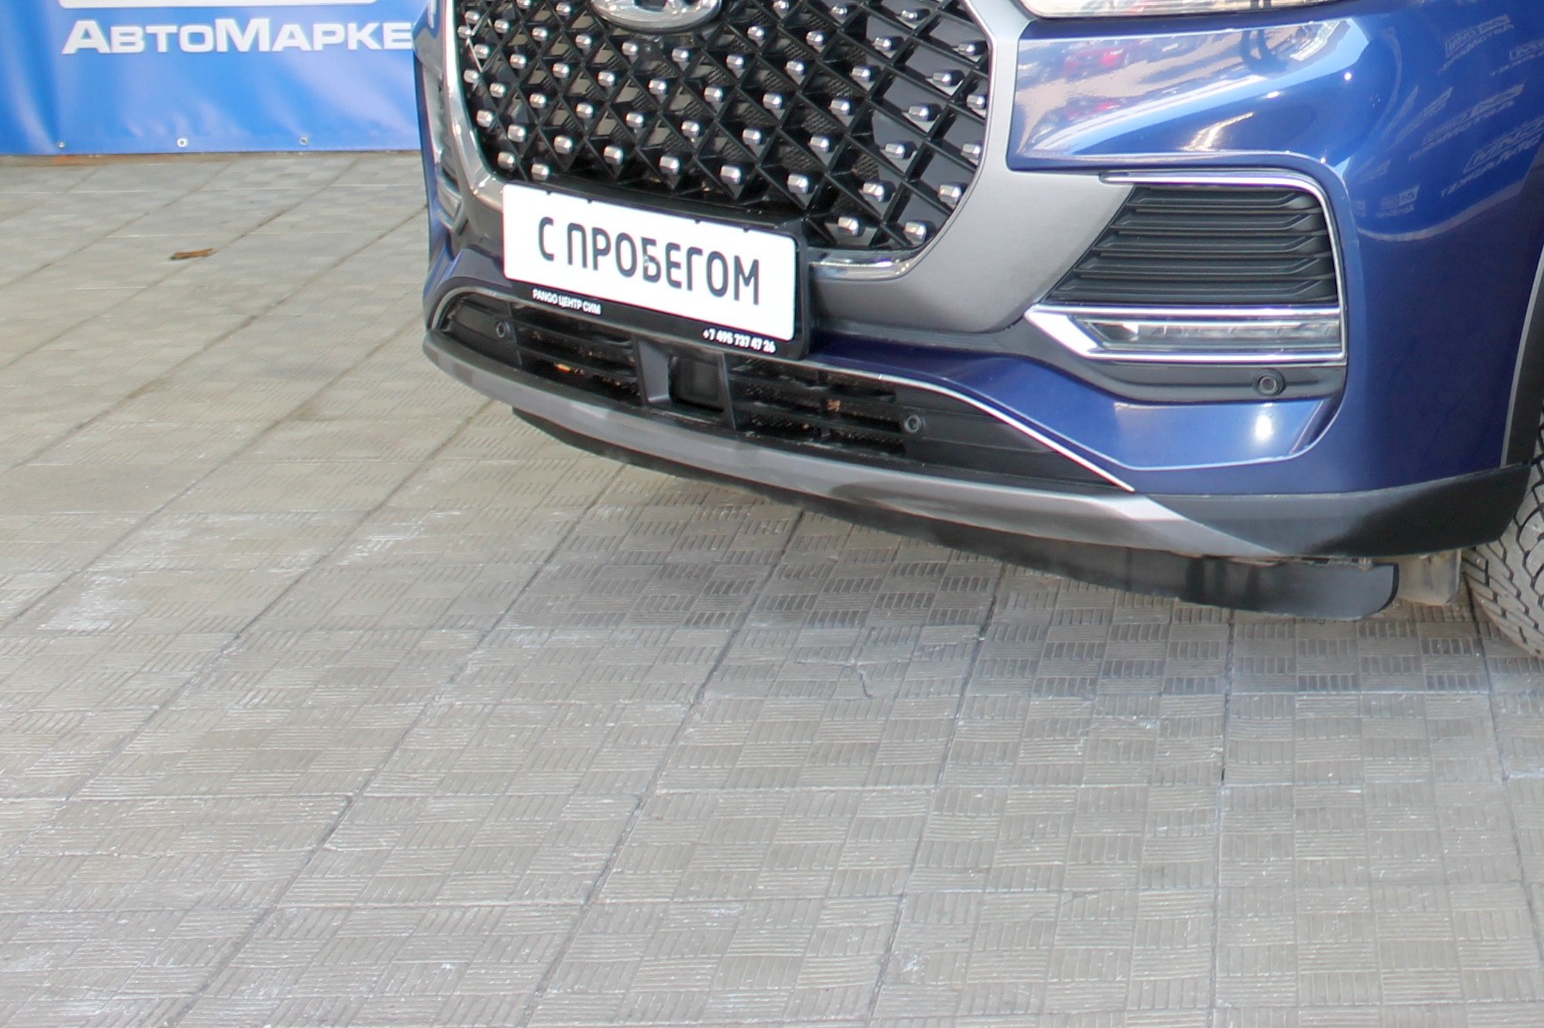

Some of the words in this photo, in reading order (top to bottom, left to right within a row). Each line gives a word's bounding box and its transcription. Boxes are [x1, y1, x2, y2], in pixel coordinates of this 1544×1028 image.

[62, 17, 412, 53] АвтоМарке
[538, 216, 555, 262] С
[566, 222, 760, 306] ПРОБЕГОМ
[532, 287, 557, 305] PANGO
[558, 293, 583, 310] ЦЕНТР
[583, 300, 602, 315] СИМ
